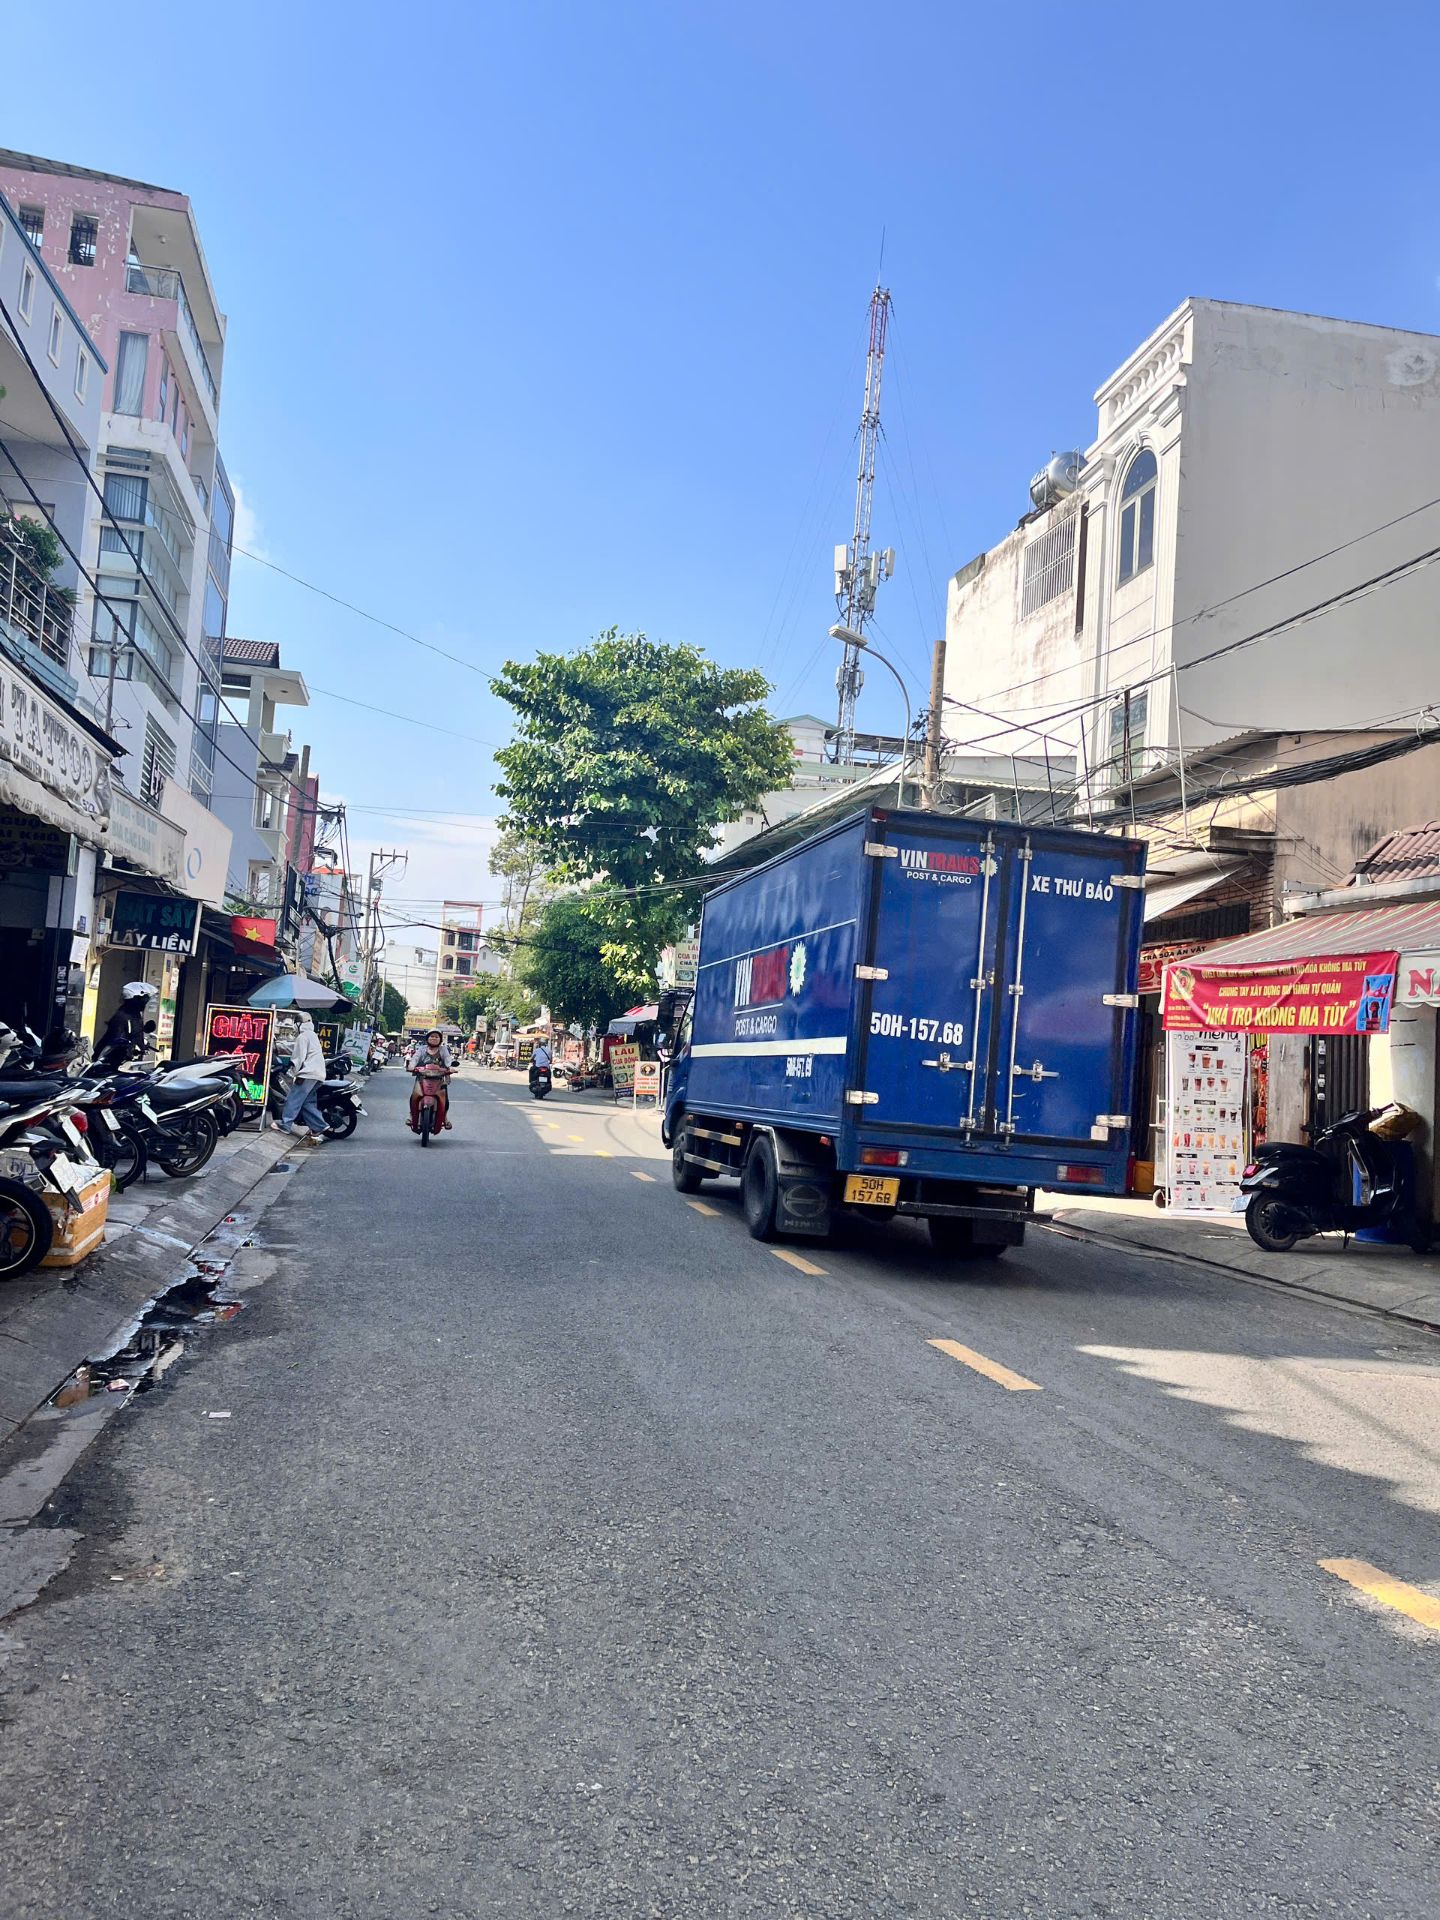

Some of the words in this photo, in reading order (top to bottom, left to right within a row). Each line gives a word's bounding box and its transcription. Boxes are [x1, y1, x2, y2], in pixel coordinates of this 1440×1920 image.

[901, 849, 980, 874] VINTRANS
[907, 871, 930, 881] POST
[940, 874, 972, 884] CARGO
[1032, 875, 1050, 892] XE
[1055, 878, 1084, 897] THƯ
[1086, 880, 1113, 901] BÁO
[112, 928, 147, 946] LẤY
[151, 932, 191, 952] LIỀN
[1319, 961, 1340, 973] KHÔNG
[1342, 961, 1353, 972] MA
[1408, 968, 1440, 996] N
[212, 1013, 267, 1043] GIẶT
[735, 1019, 749, 1035] POST
[755, 1016, 777, 1034] CARGO
[870, 1012, 964, 1046] 50H-157.68
[1231, 1007, 1253, 1030] TRỌ
[1254, 1004, 1297, 1027] KHÔNG
[1298, 1006, 1319, 1027] MA
[861, 1178, 884, 1190] 50H
